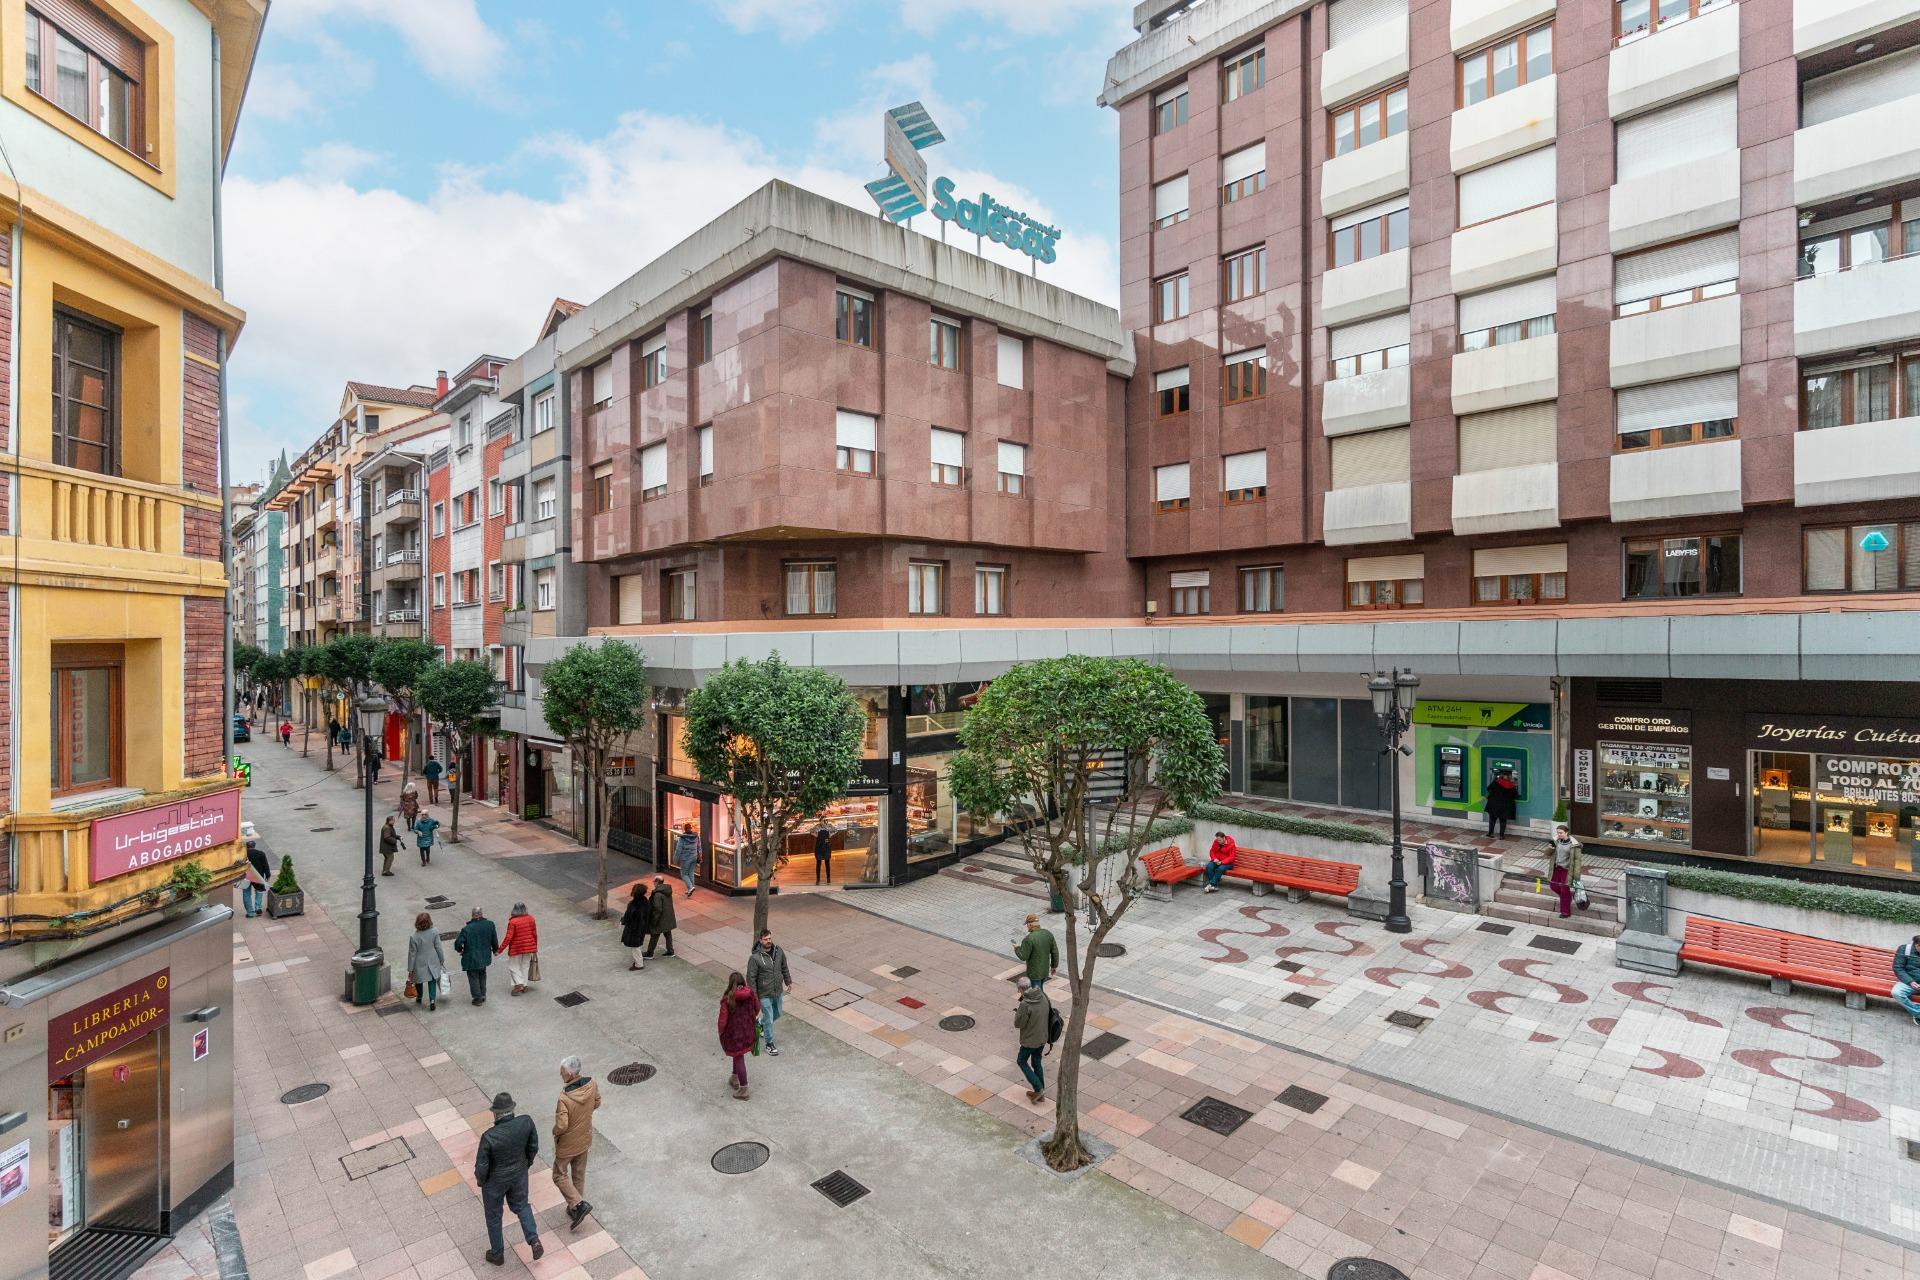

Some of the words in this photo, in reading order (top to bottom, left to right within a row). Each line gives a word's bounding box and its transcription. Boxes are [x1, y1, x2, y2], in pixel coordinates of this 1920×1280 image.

[931, 176, 1057, 264] Salesas
[72, 676, 84, 765] ASESORES
[1522, 721, 1544, 729] Unicaja
[1614, 716, 1650, 724] COMPRO
[1647, 725, 1689, 733] EMPEÑOS
[1757, 724, 1847, 742] Joyerías
[1611, 750, 1677, 760] REBAJAS
[1578, 750, 1589, 784] COMPRO
[1826, 759, 1903, 775] COMPRO
[1829, 775, 1872, 787] TODO
[1876, 779, 1897, 789] AL
[128, 834, 213, 869] ABOGADOS
[72, 989, 151, 1035] LIBRERIA
